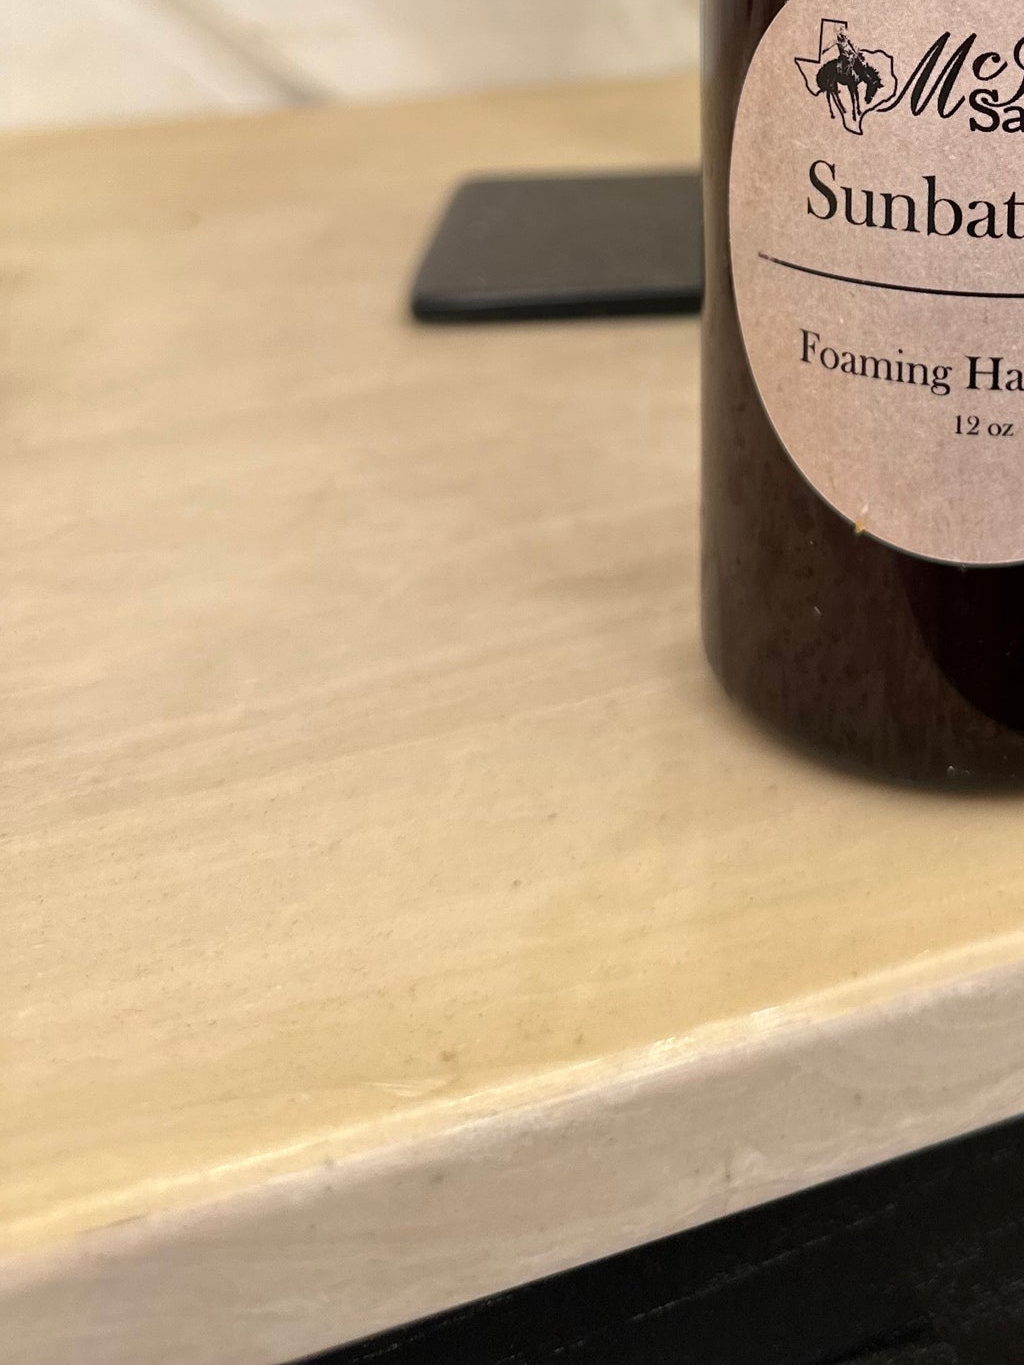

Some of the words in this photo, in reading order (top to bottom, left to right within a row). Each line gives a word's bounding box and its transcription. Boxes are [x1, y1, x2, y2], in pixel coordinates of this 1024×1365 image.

[799, 328, 953, 396] Foaming
[953, 415, 980, 436] 12
[987, 420, 1014, 437] oz
